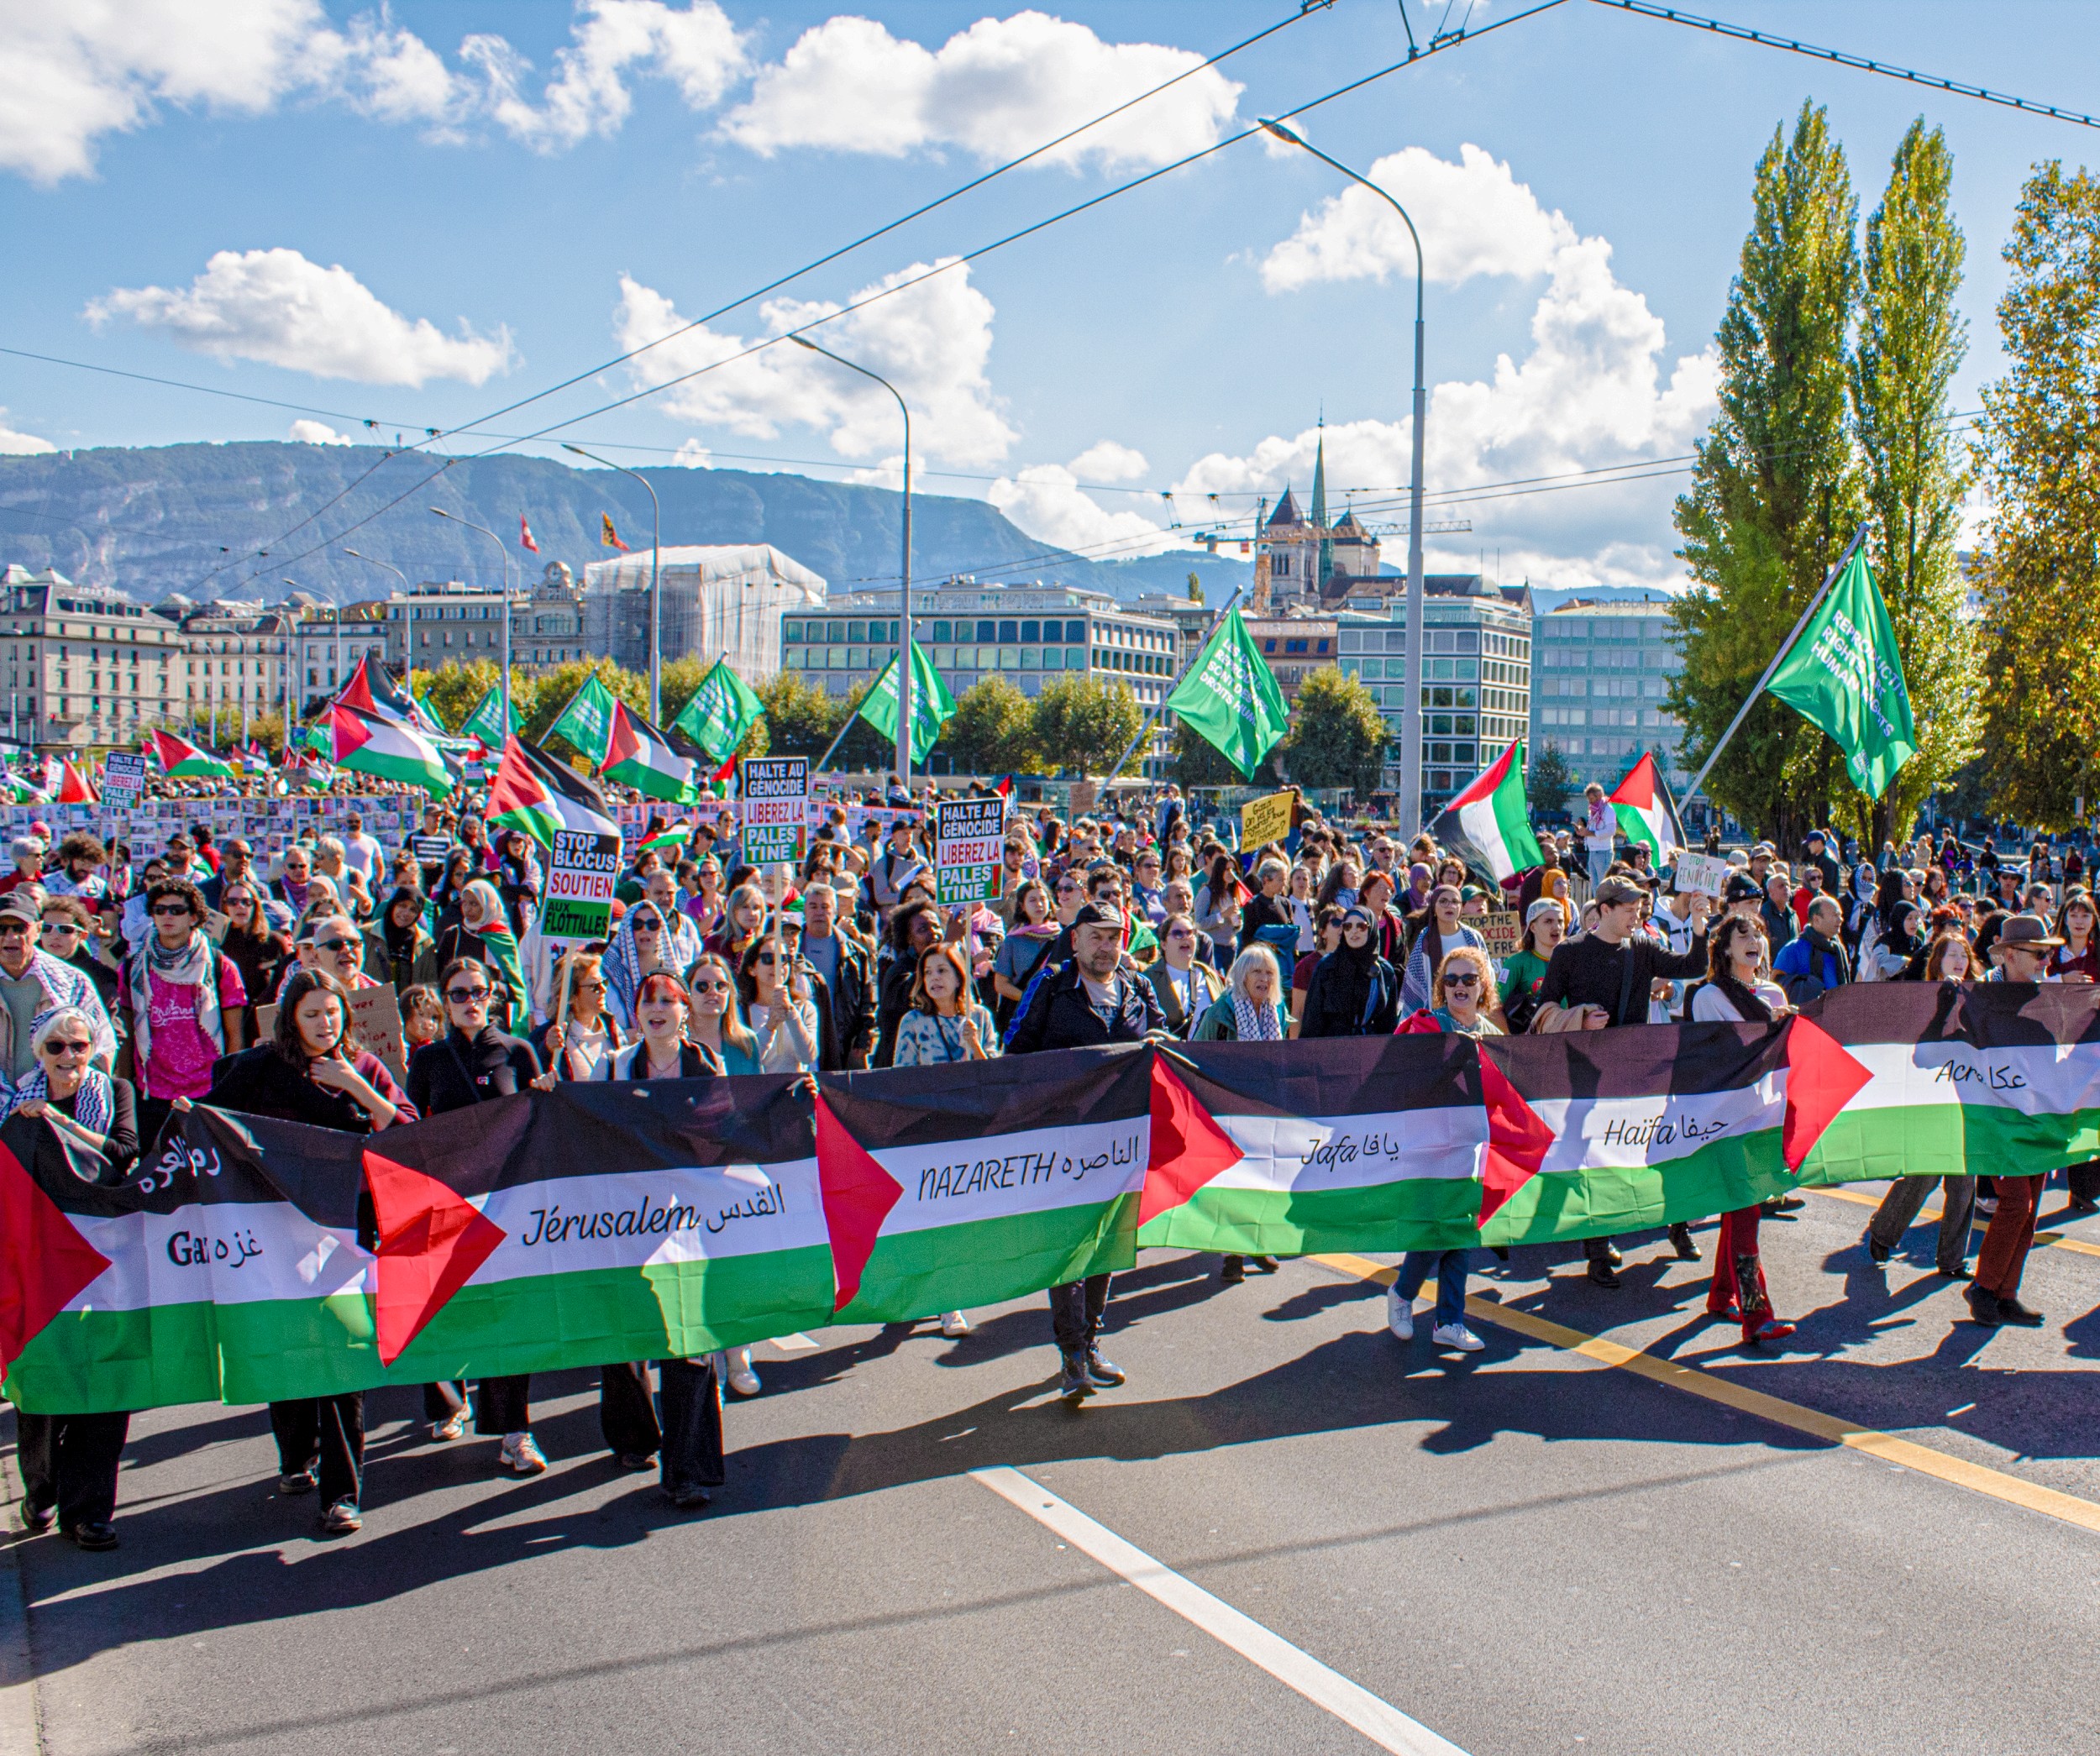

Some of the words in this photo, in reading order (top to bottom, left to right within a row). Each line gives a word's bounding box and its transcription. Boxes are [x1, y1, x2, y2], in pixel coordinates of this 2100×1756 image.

[1821, 625, 1866, 674] RIGHTS
[1833, 609, 1905, 698] REPRODUCTIV
[1810, 641, 1861, 691] HUMAN
[1199, 671, 1235, 705] DROITS
[748, 763, 787, 778] HALTE
[788, 763, 805, 778] AU
[792, 801, 805, 822] LA
[942, 805, 982, 821] HALTE
[984, 803, 1001, 818] AU
[554, 831, 598, 852] STOP
[747, 826, 797, 845] PALES
[553, 849, 617, 871] BLOCUS
[747, 844, 791, 862] TINE
[987, 841, 1000, 862] LA
[1688, 855, 1705, 866] STOP
[551, 872, 614, 899] SOUTIEN
[940, 865, 992, 886] PALES
[940, 883, 985, 902] TINE
[548, 901, 570, 913] AUX
[543, 911, 609, 936] FLOTTILLES
[1461, 916, 1488, 928] STOP
[1488, 915, 1512, 925] THE
[1481, 926, 1517, 941] OCIDE
[1494, 941, 1516, 955] FRE
[1989, 1065, 2027, 1089] عكا
[1604, 1115, 1677, 1153] Haïfa
[1681, 1114, 1729, 1141] حيفا
[1301, 1135, 1359, 1172] Jafa
[1362, 1133, 1399, 1161] يافا
[918, 1151, 1057, 1201] NAZARETH
[706, 1182, 785, 1234] القدس
[522, 1195, 701, 1246] Jérusalem
